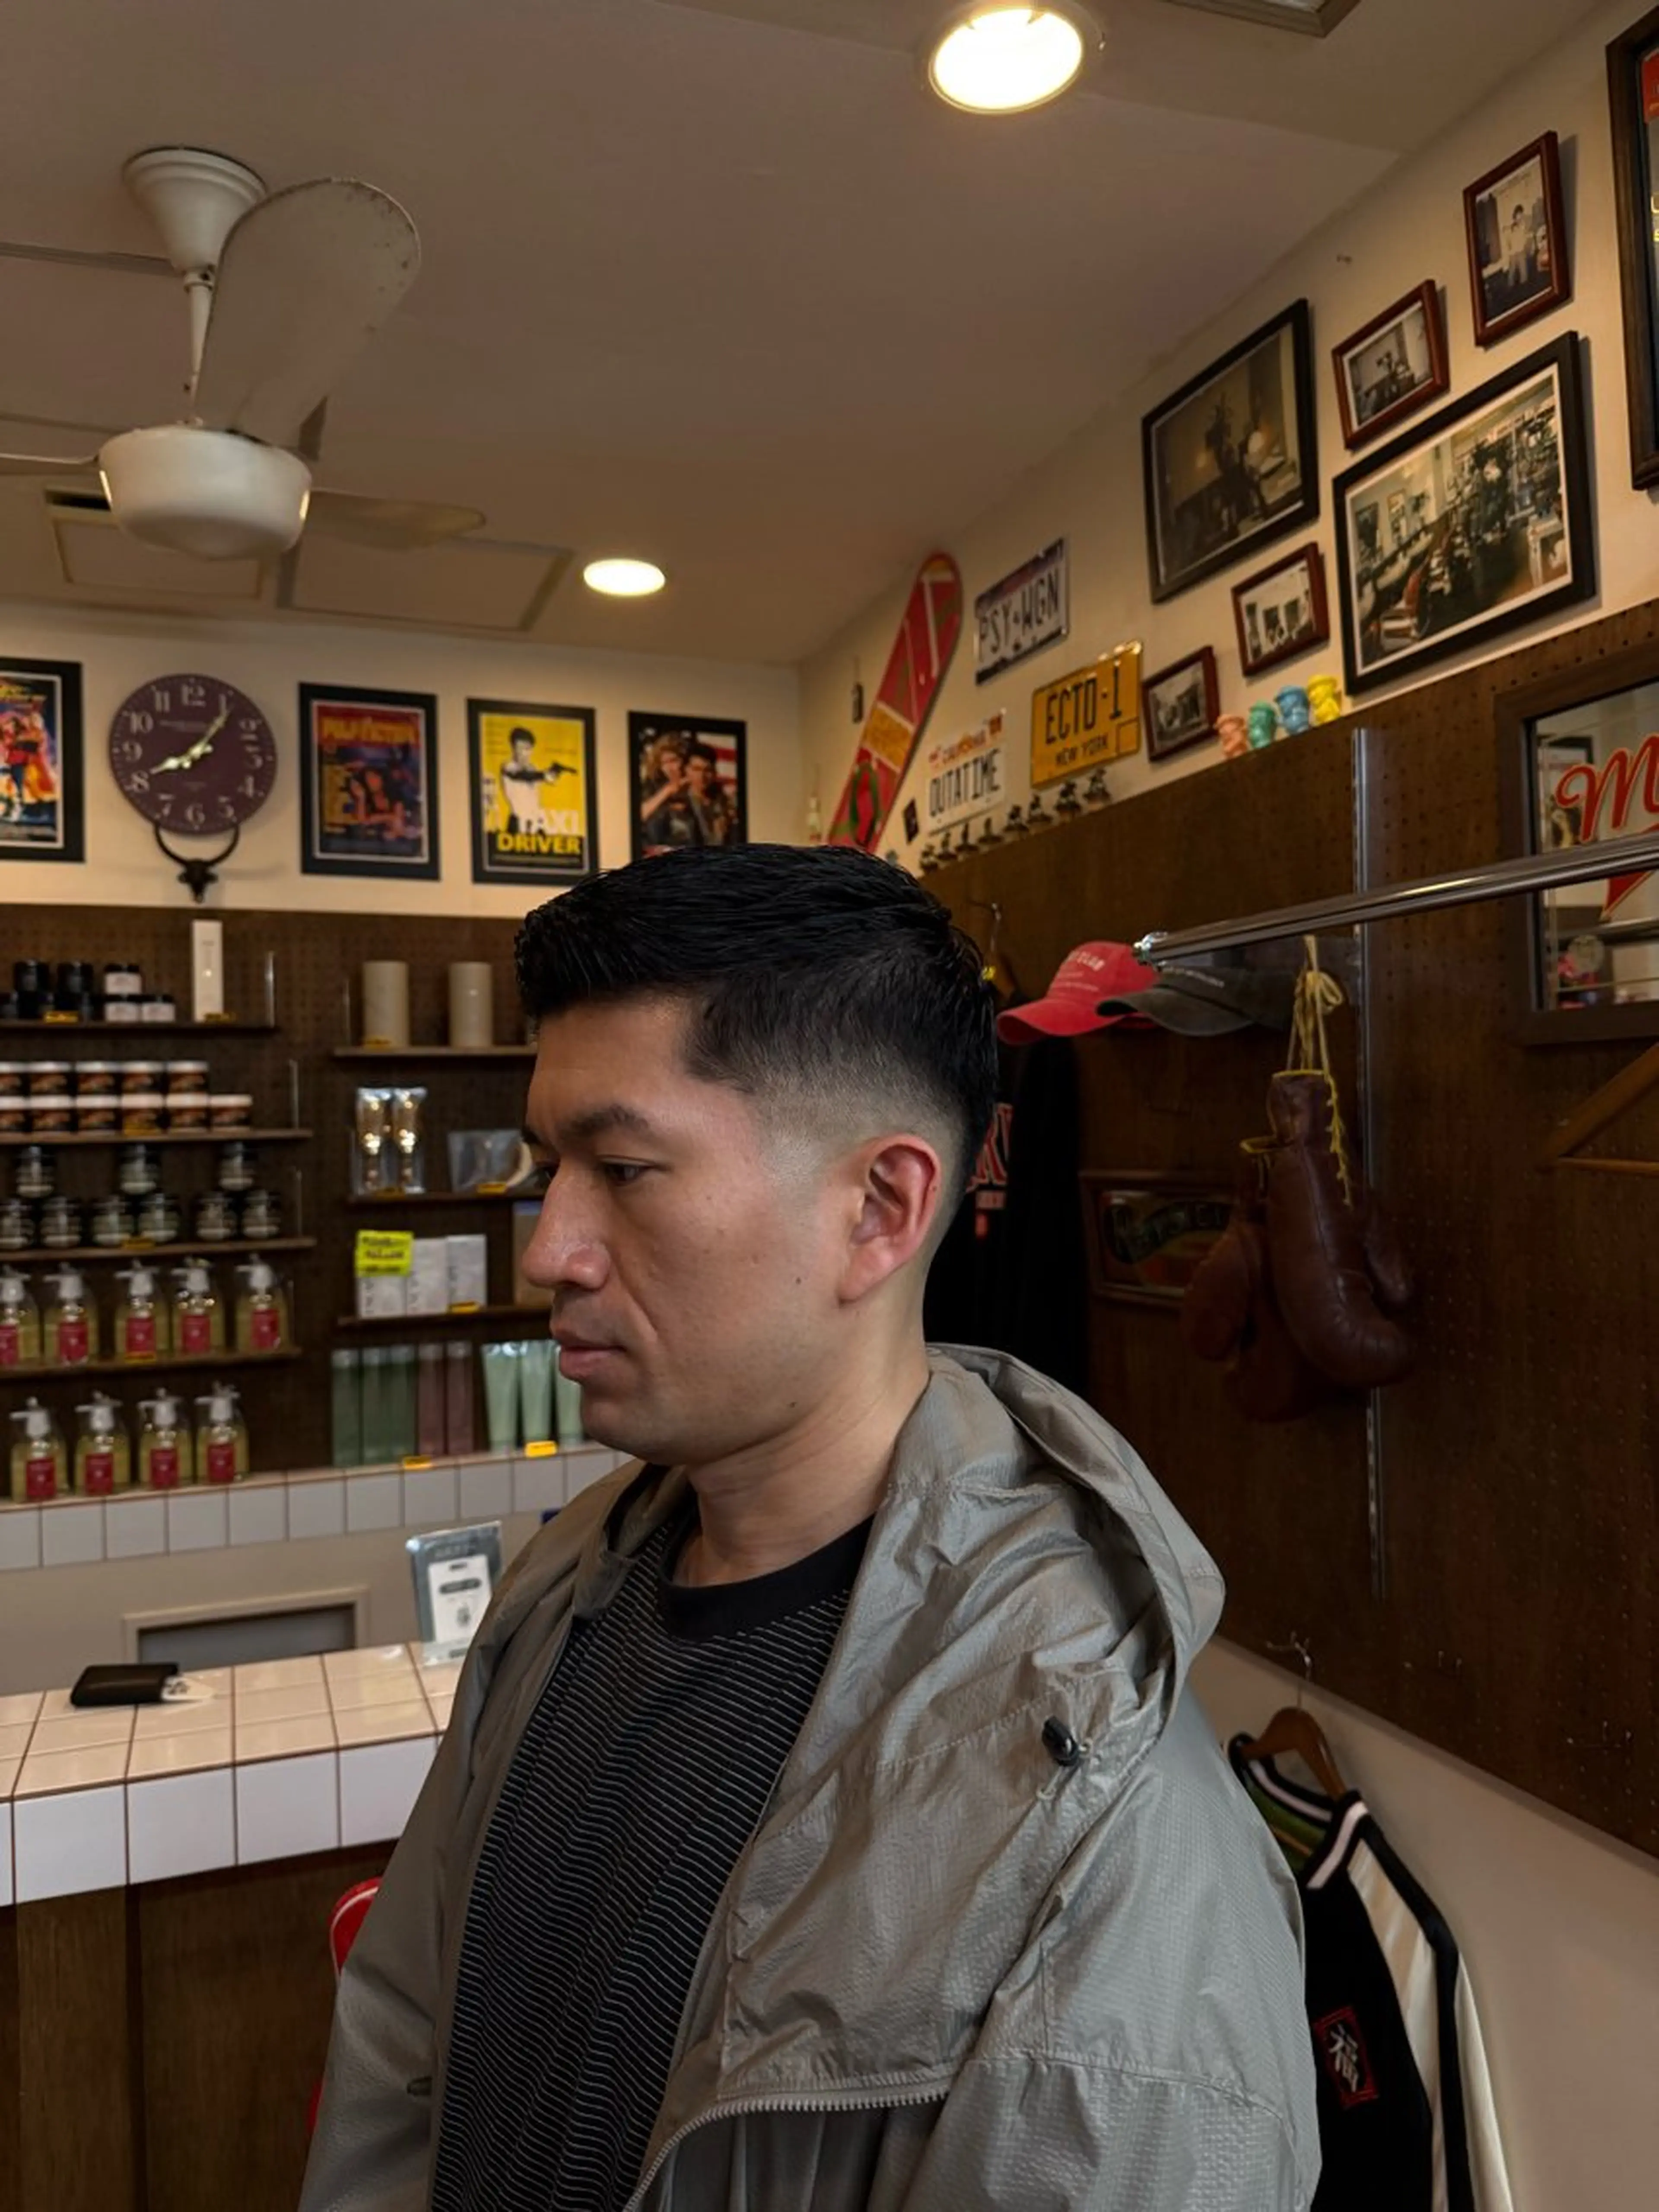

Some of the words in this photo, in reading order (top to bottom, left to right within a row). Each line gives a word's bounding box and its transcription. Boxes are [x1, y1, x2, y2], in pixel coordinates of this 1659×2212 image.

[154, 690, 171, 713] 11
[181, 684, 206, 707] 12
[1046, 666, 1122, 745] ECTO-1
[129, 711, 154, 734] 10
[122, 740, 143, 762] 9
[130, 770, 150, 793] 8
[184, 803, 206, 824] 6
[497, 832, 582, 855] DRIVER
